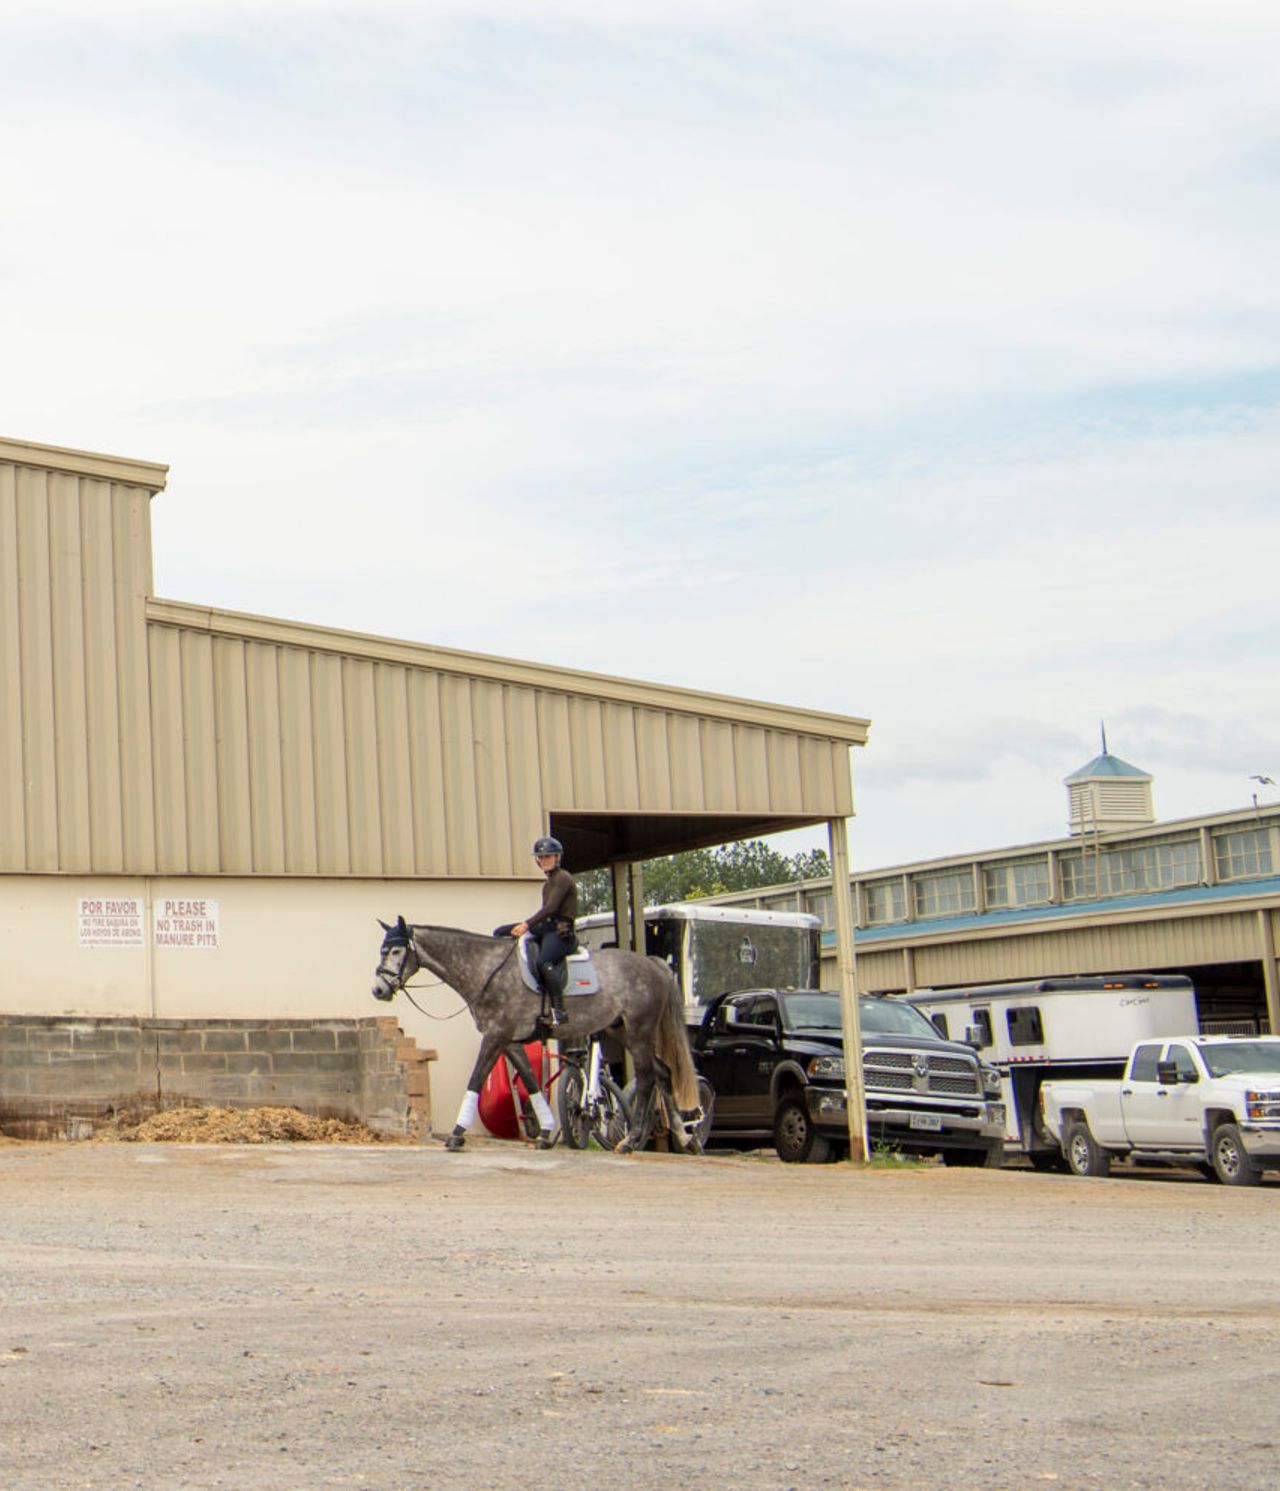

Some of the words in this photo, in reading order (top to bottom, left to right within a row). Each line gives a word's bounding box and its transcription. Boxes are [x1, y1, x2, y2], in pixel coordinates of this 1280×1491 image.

[82, 901, 103, 914] POR
[105, 901, 137, 914] FAVOR
[165, 901, 207, 915] PLEASE
[157, 920, 170, 931] NO
[172, 920, 203, 931] TRASH
[205, 920, 215, 931] IN
[156, 934, 195, 945] MANURE
[197, 934, 218, 946] PITS
